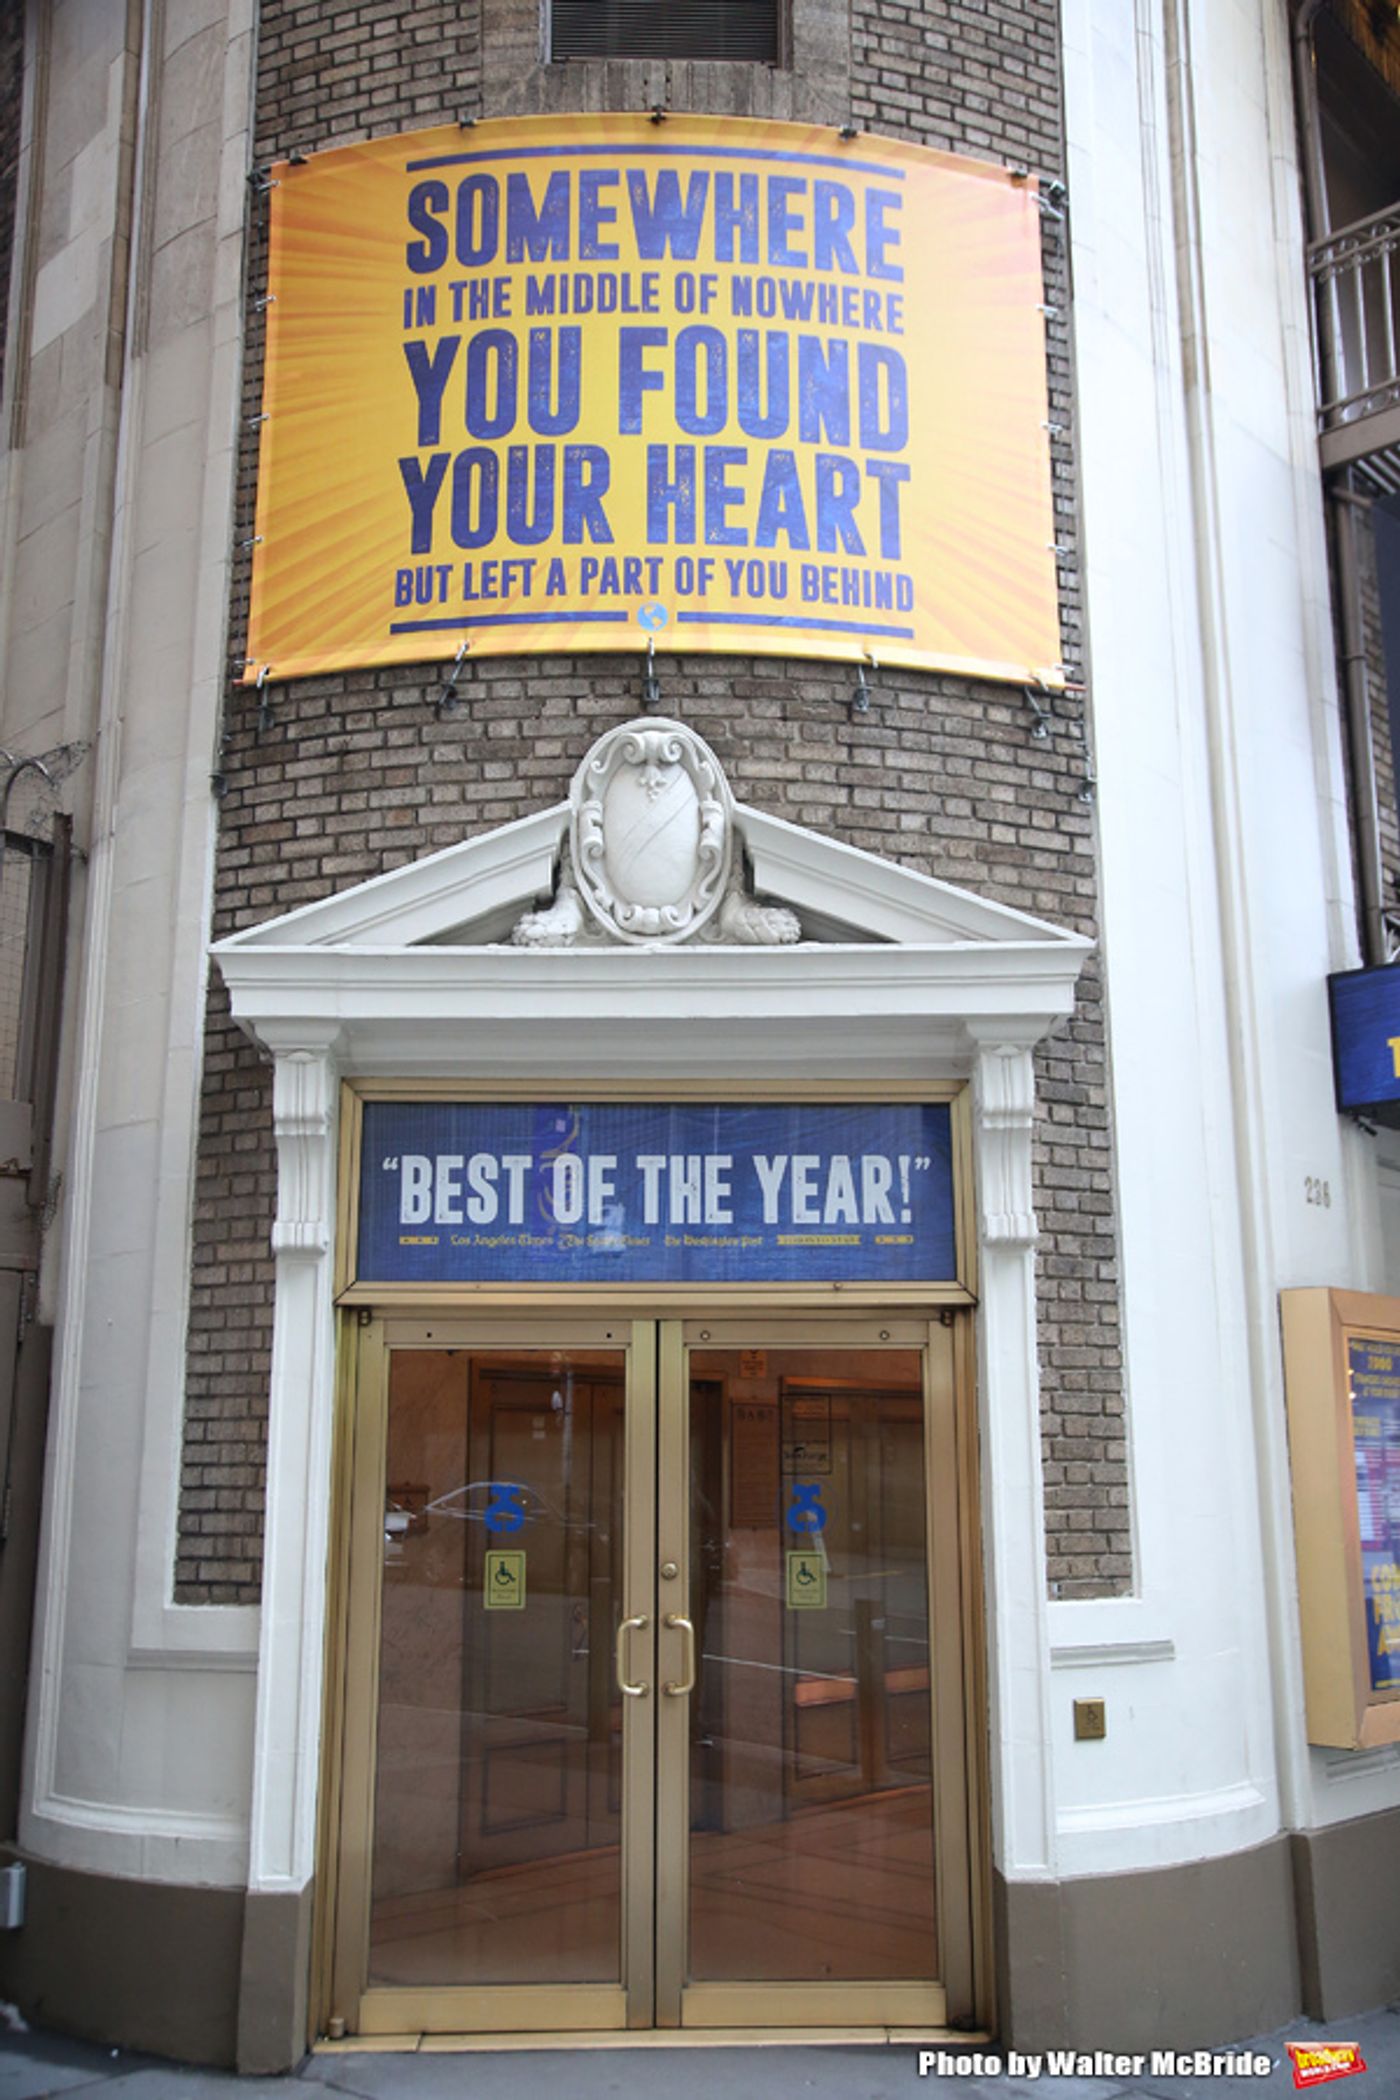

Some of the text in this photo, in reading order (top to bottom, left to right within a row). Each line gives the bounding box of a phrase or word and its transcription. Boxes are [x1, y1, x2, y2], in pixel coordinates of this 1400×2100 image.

[406, 168, 906, 284] SOMEWHERE
[403, 272, 906, 336] IN THE MIDDLE OF NOWHERE
[403, 324, 910, 454] YOU FOUND
[399, 443, 912, 561] YOUR HEART
[394, 556, 915, 613] BUT LEFT A PART OF YOU BEHIND
[383, 1154, 931, 1225] “BEST OF THE YEAR!”
